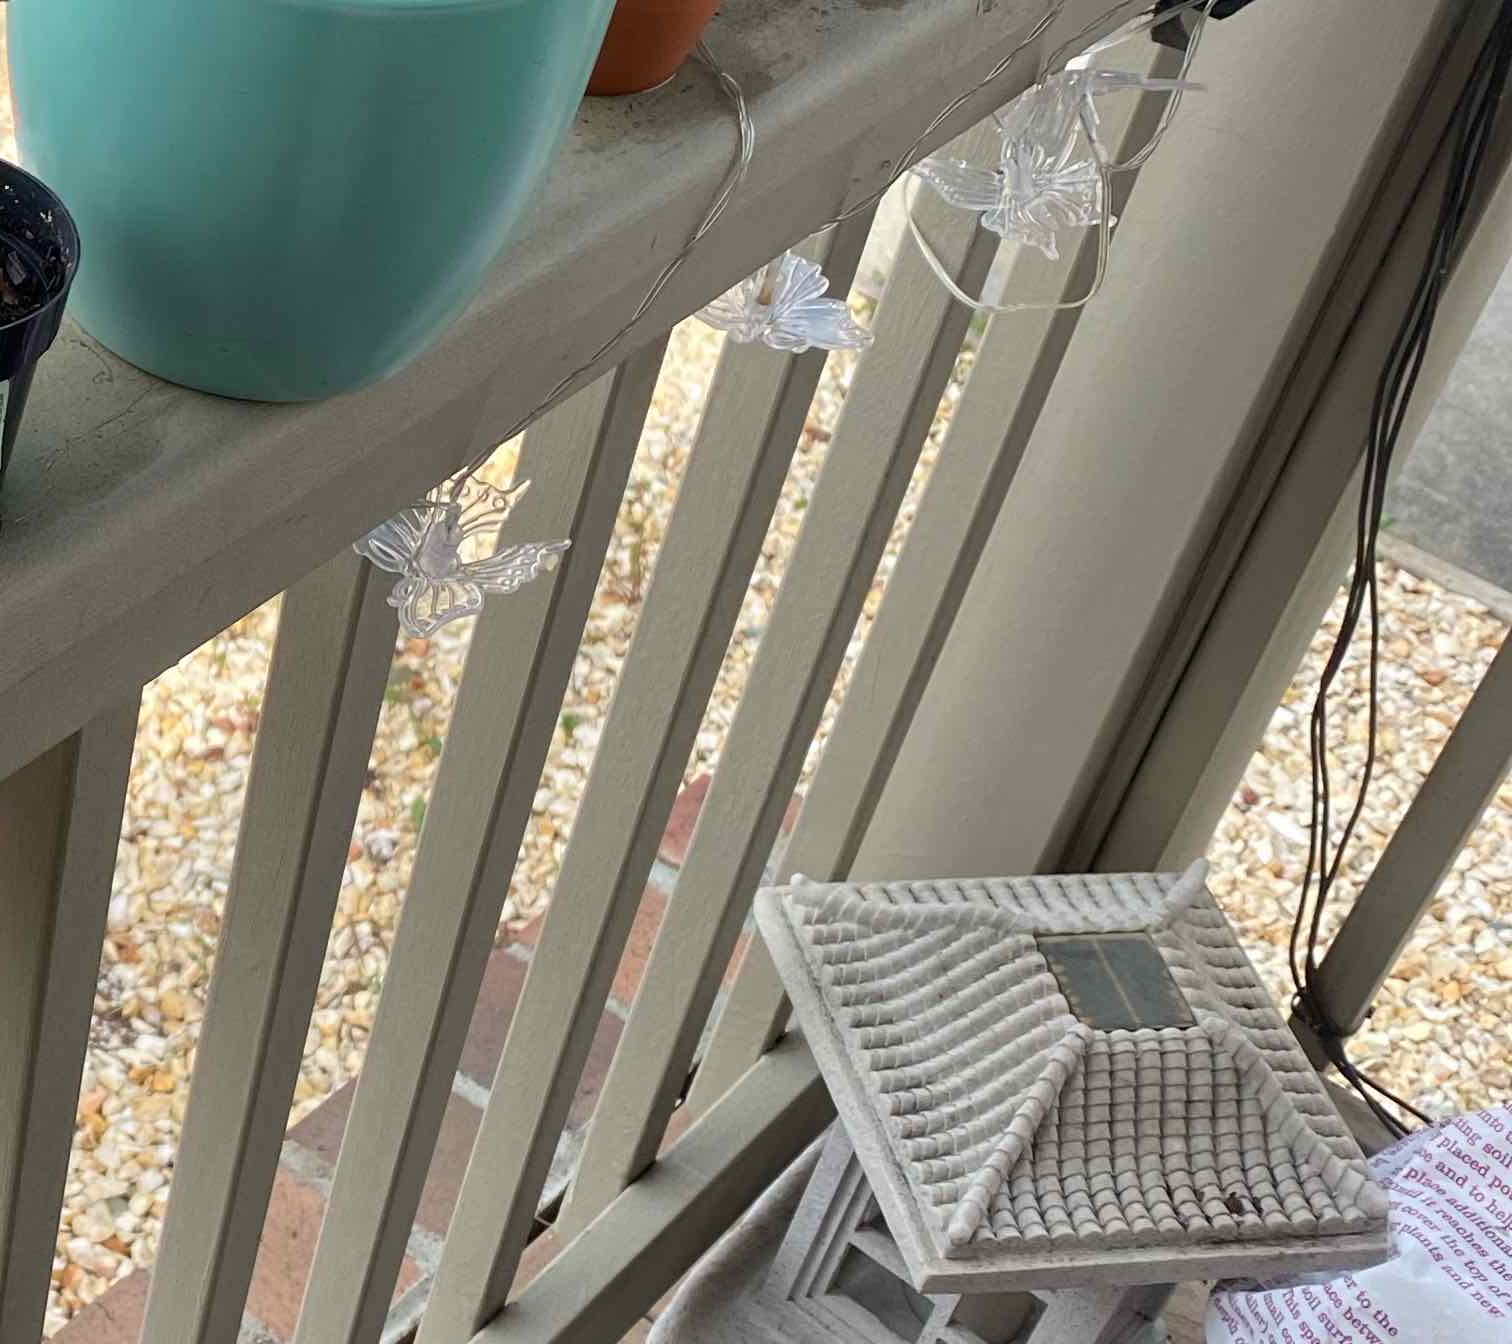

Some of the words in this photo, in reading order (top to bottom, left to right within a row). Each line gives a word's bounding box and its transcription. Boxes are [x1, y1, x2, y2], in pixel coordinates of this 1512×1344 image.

[1437, 1136, 1491, 1178] placed
[1435, 1161, 1469, 1188] and
[1469, 1185, 1485, 1202] to
[1435, 1209, 1489, 1257] reaches
[1464, 1260, 1488, 1282] top
[1356, 1290, 1372, 1308] to
[1373, 1309, 1398, 1337] the
